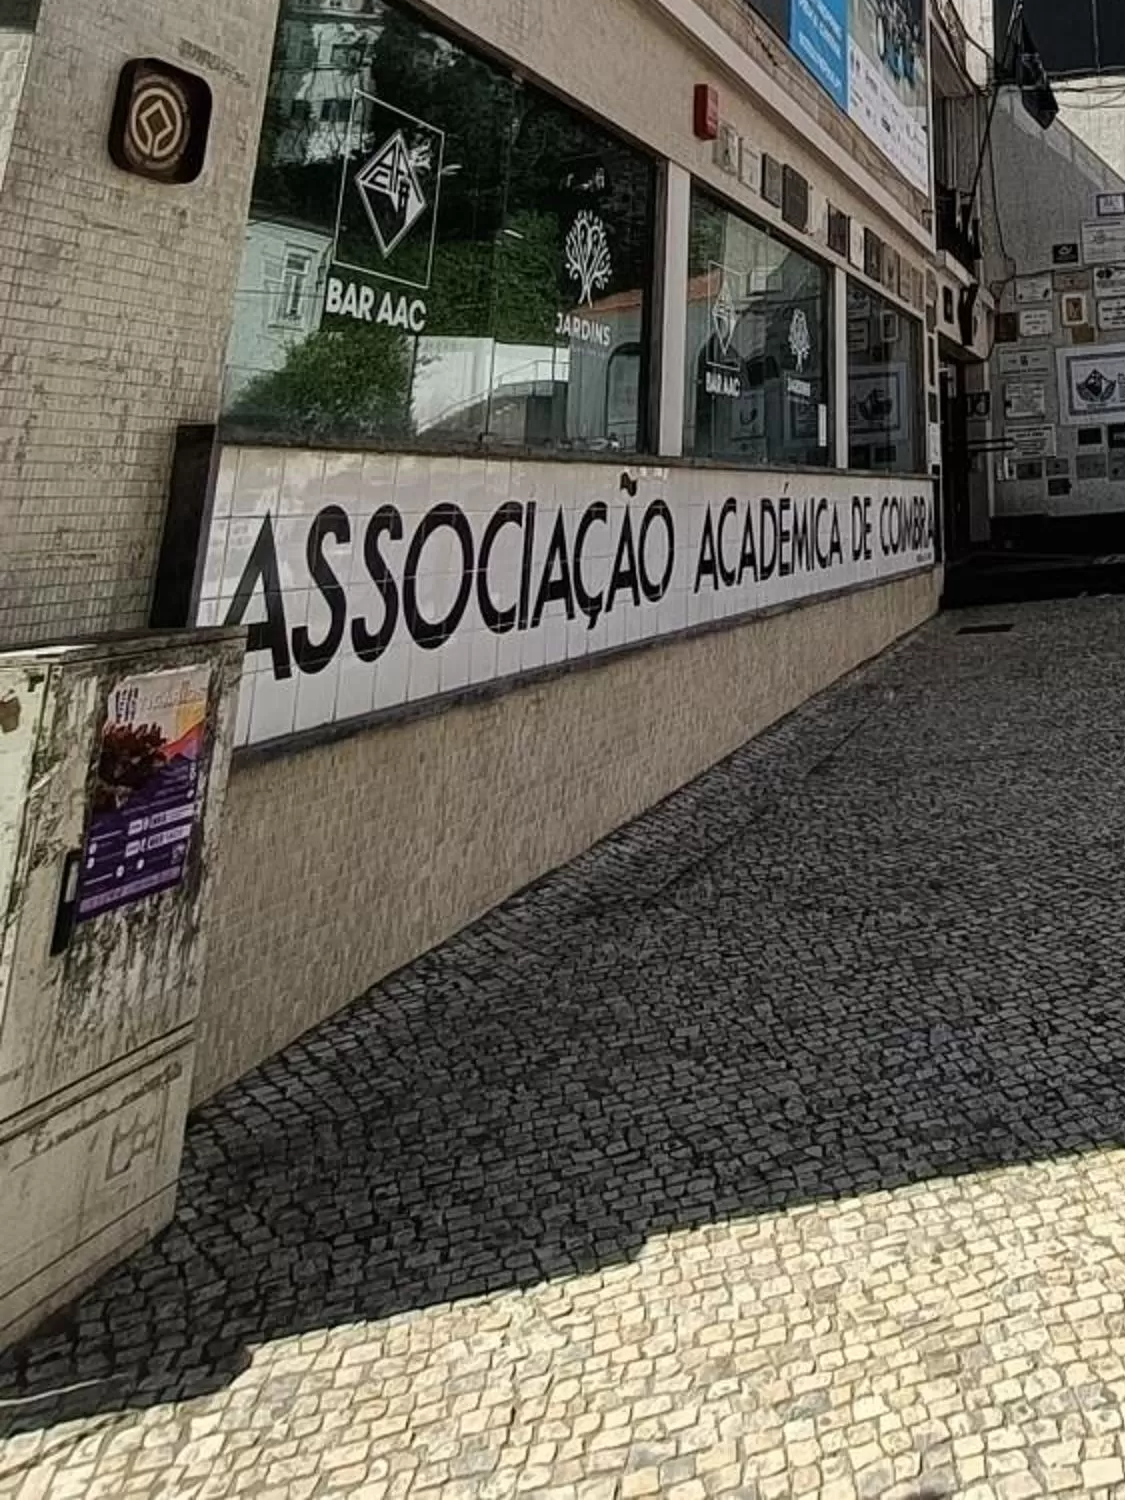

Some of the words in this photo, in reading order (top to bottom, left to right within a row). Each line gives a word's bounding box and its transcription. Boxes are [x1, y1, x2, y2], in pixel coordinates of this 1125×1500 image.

[326, 277, 375, 321] BAR
[377, 292, 426, 331] AAC
[555, 312, 611, 347] JARDINS
[223, 470, 675, 680] ASSOCIAÇÃO
[694, 482, 843, 593] ACADÉMICA
[852, 496, 872, 561] DE
[880, 496, 933, 556] COIMBRA
